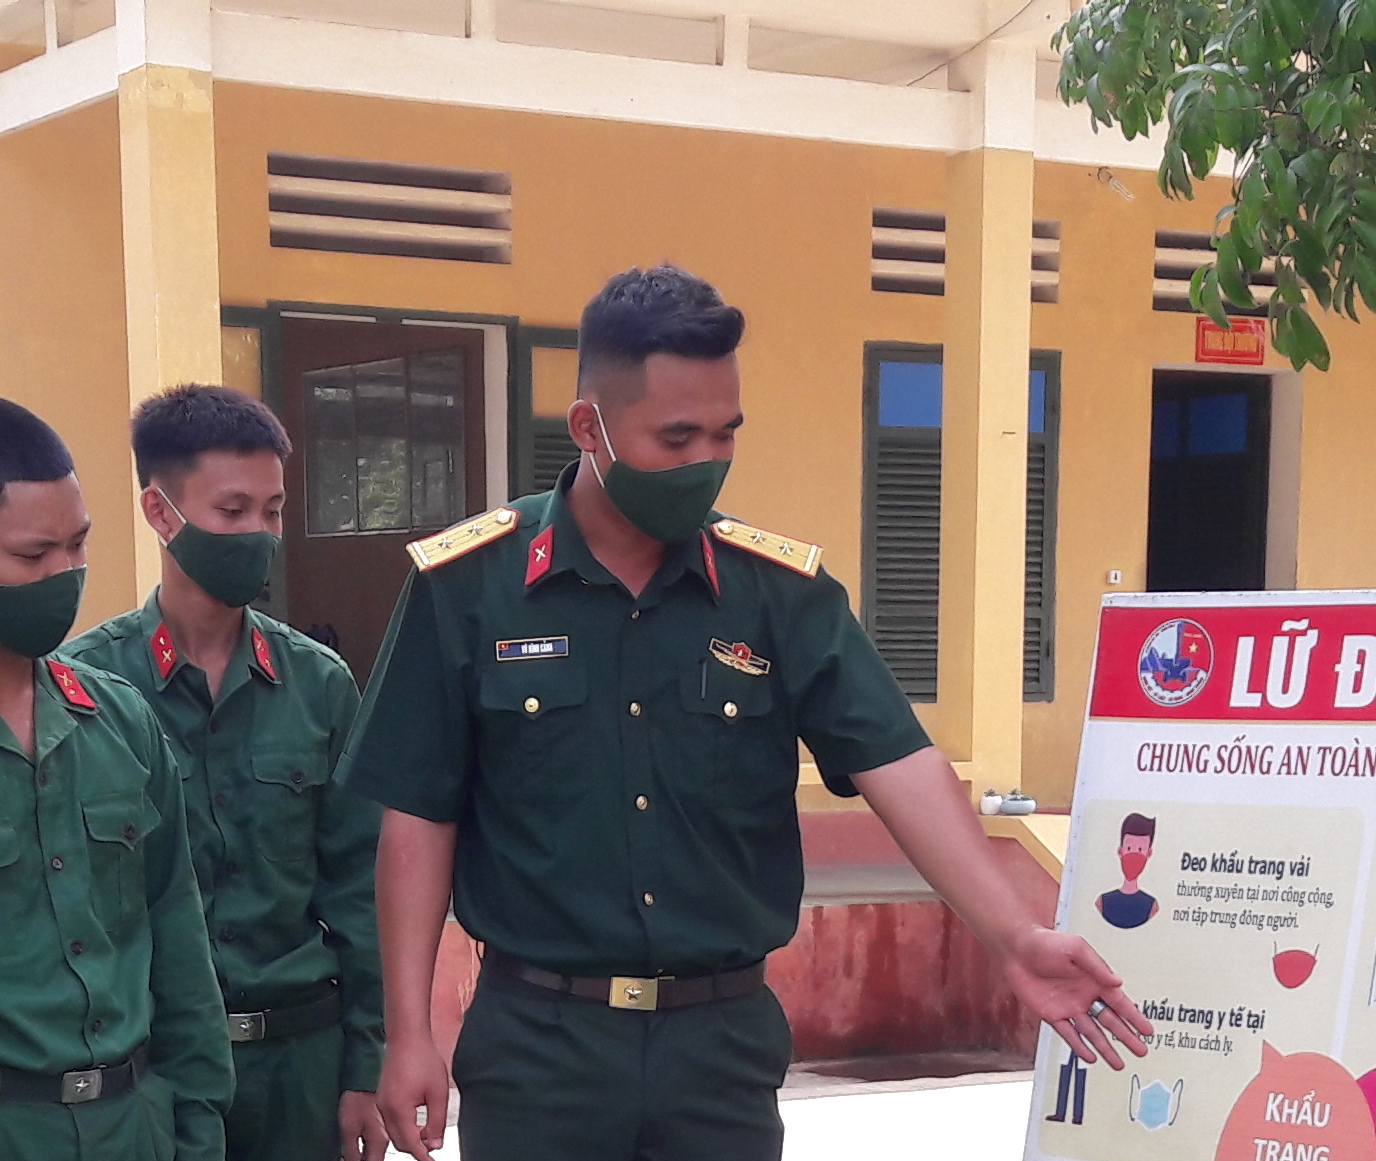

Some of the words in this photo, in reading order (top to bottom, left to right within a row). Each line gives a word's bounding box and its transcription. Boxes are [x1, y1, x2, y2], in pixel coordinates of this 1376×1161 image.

[1229, 619, 1318, 708] LỮ
[1137, 743, 1209, 774] CHUNG
[1214, 735, 1273, 775] SỐNG
[1277, 746, 1310, 776] AN
[1181, 852, 1206, 872] Đeo
[1210, 850, 1243, 874] khẩu
[1248, 856, 1284, 880] trang
[1290, 856, 1310, 877] vải
[1142, 998, 1173, 1021] khẩu
[1178, 1004, 1213, 1030] trang
[1217, 1011, 1225, 1031] y
[1229, 1007, 1245, 1028] tế
[1247, 1010, 1265, 1034] tại
[1266, 1090, 1331, 1128] KHẨU
